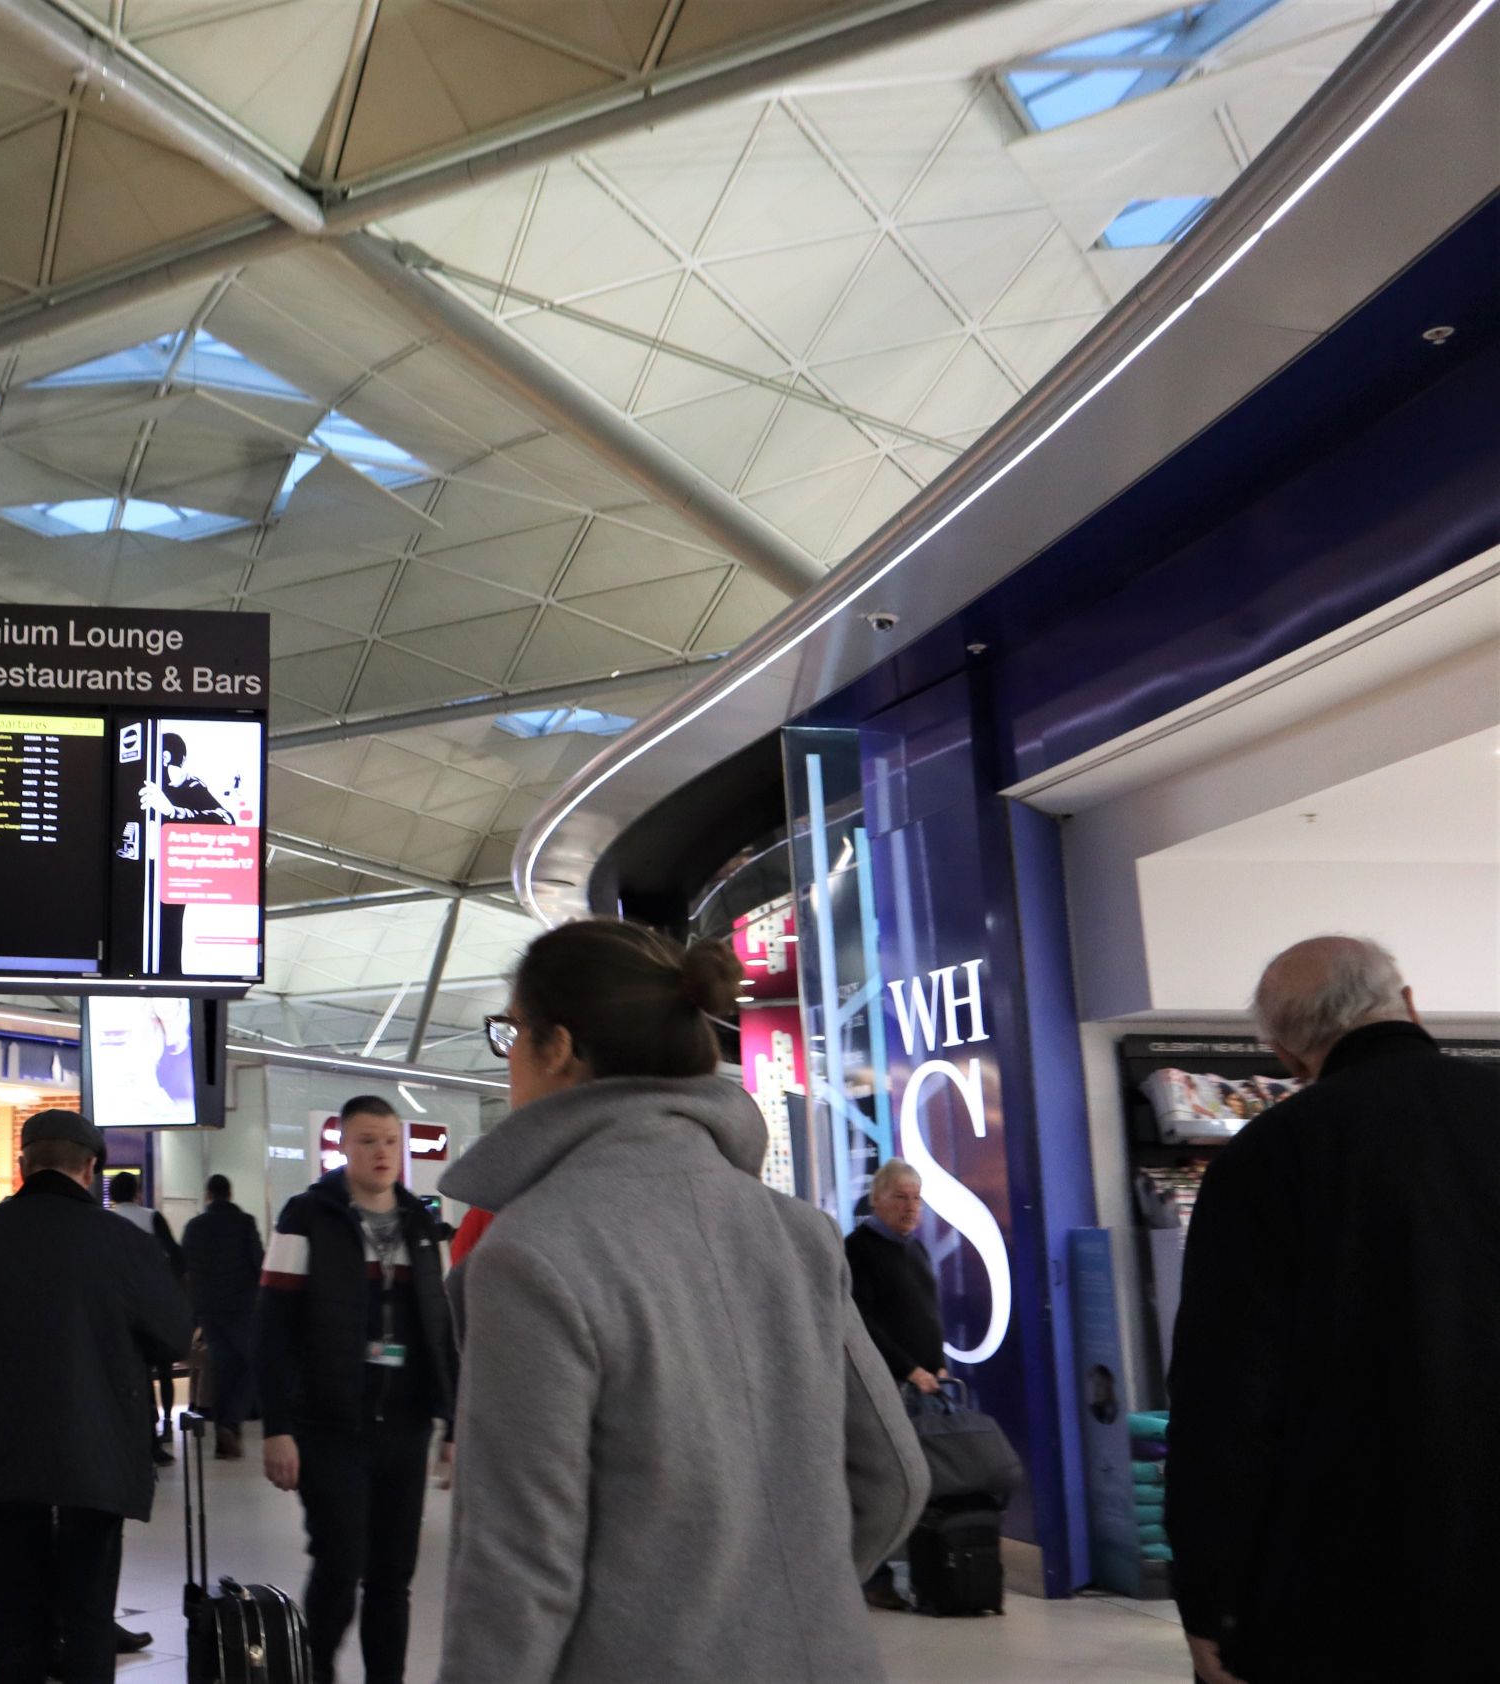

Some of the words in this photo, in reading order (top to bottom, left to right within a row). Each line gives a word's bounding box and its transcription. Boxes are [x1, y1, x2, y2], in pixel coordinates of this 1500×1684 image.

[68, 619, 184, 656] Lounge
[161, 666, 184, 693] &
[192, 667, 263, 695] Bars
[168, 831, 190, 842] Are
[190, 832, 216, 847] they
[217, 833, 250, 847] going
[167, 856, 195, 870] they
[887, 958, 990, 1056] WH
